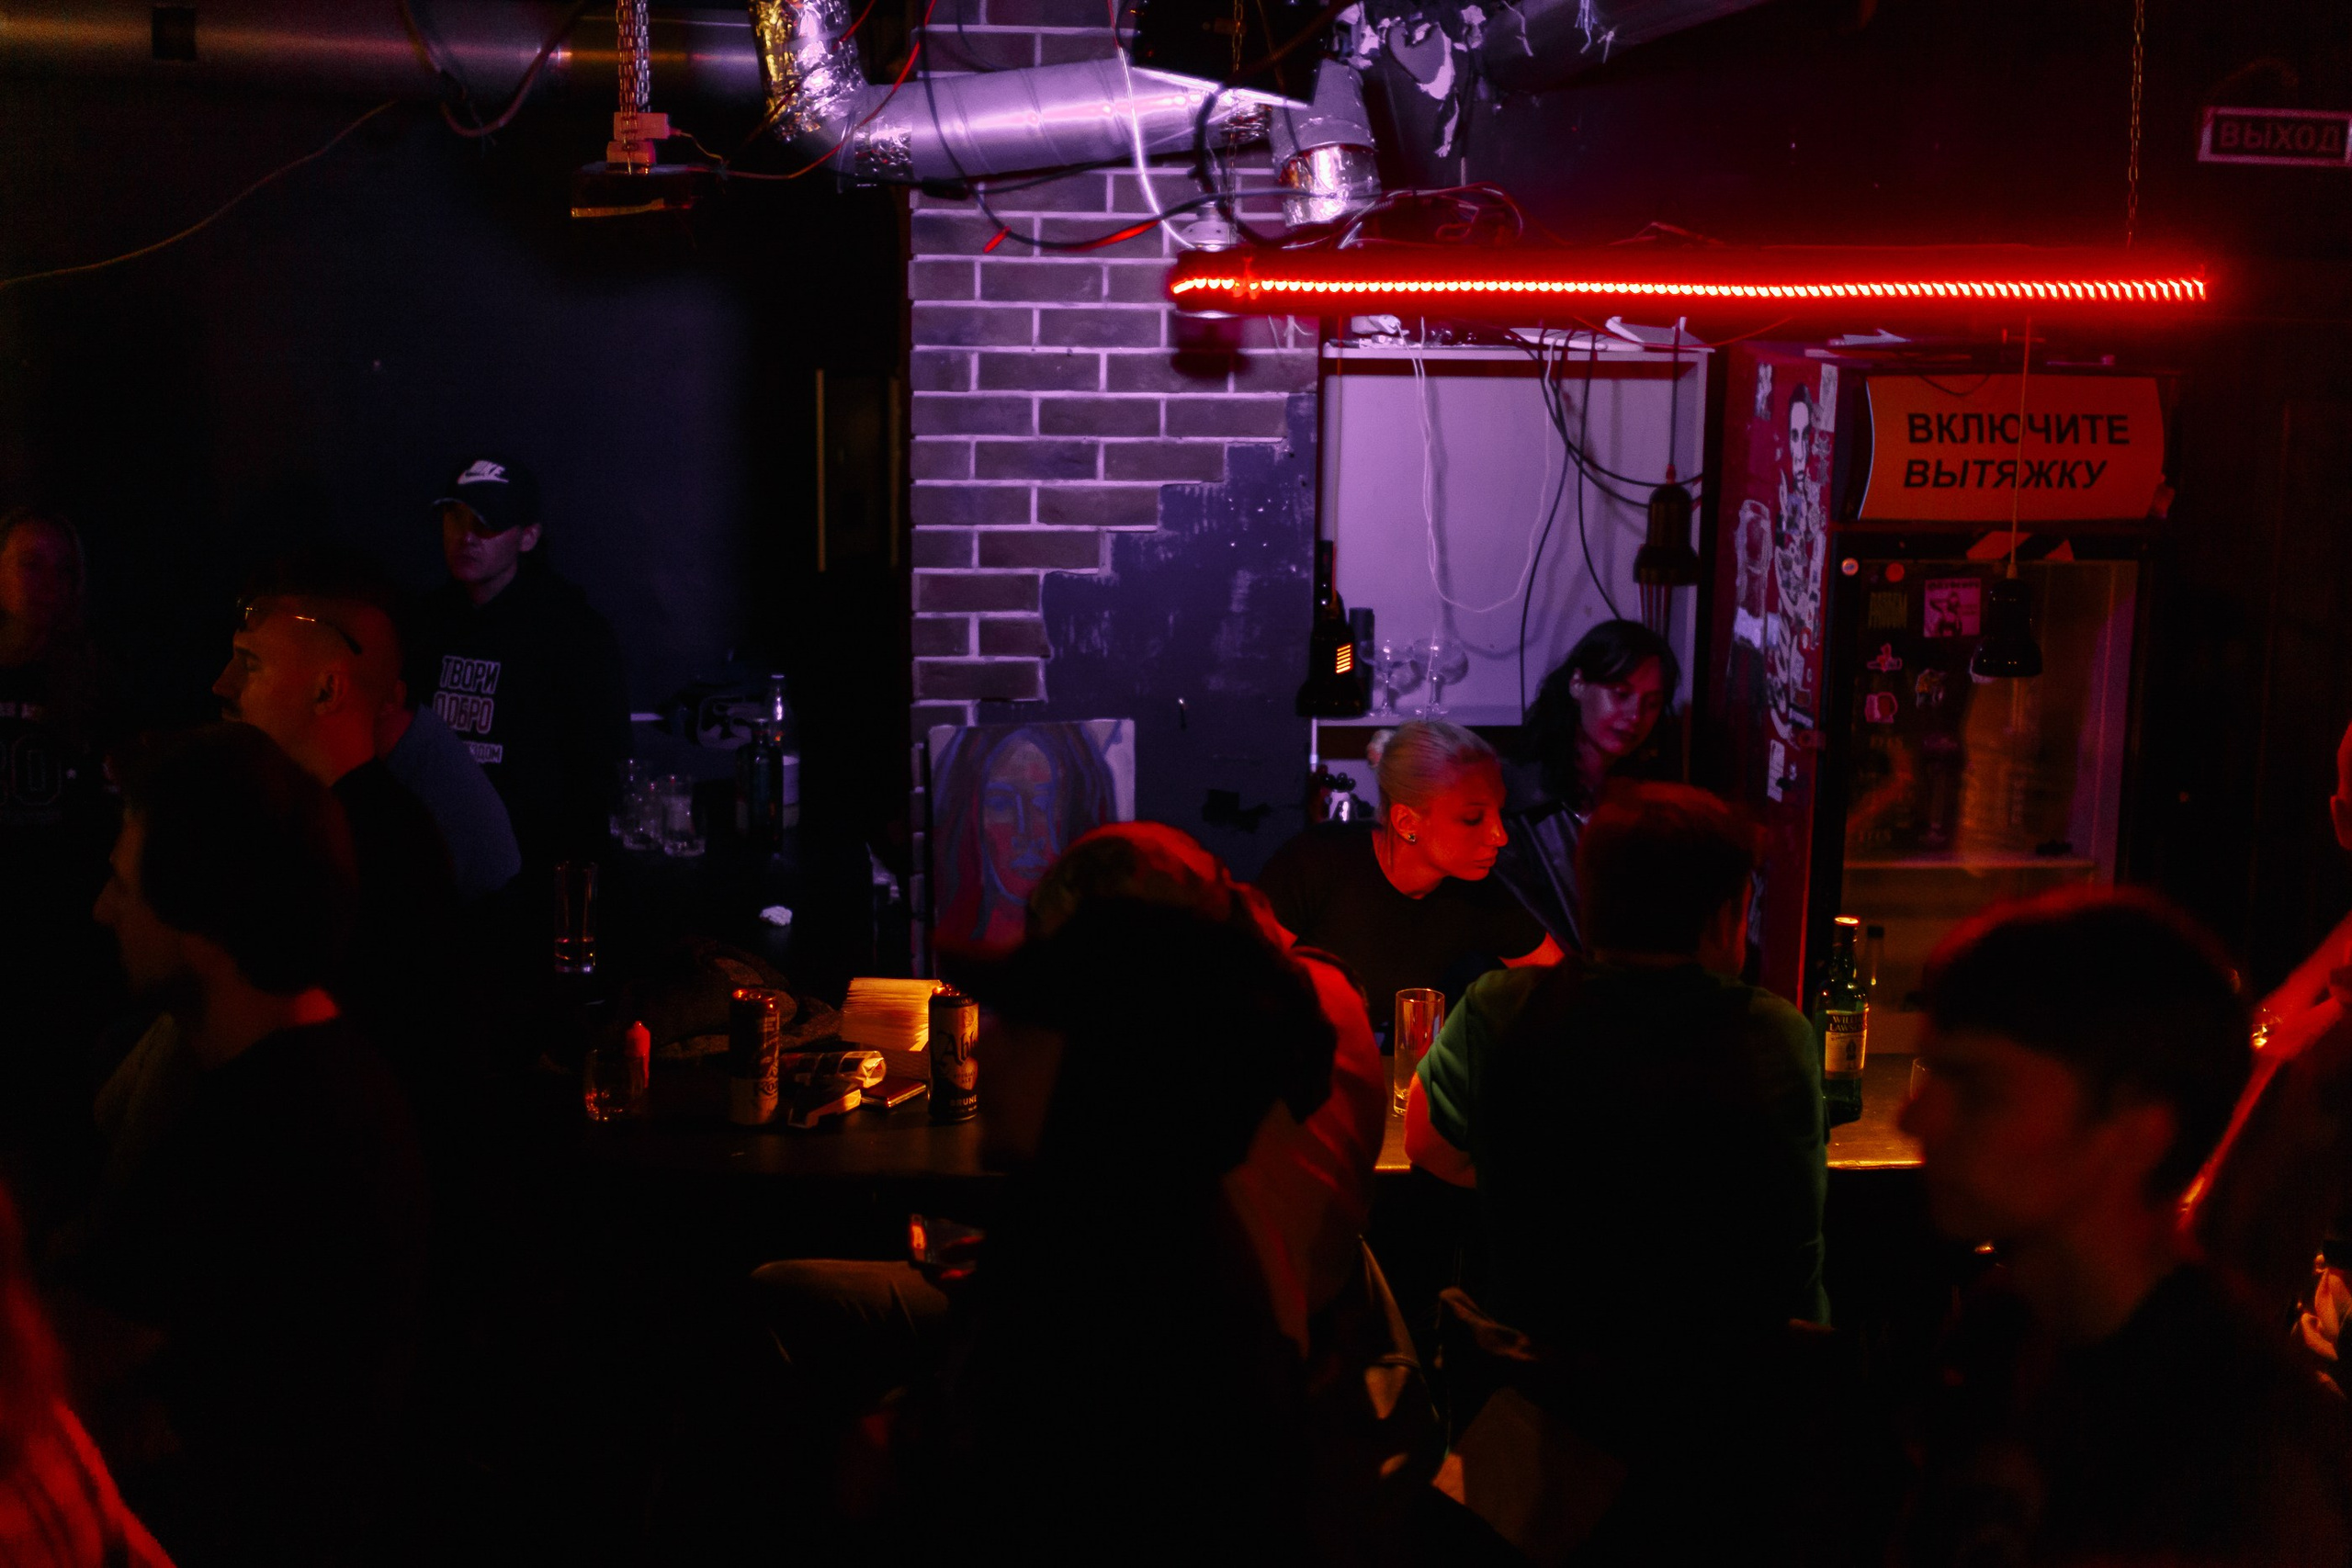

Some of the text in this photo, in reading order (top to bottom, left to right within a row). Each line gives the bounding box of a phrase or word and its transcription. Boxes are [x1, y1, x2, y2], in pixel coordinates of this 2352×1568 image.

[2220, 120, 2341, 153] ВЫХОД
[1907, 412, 2130, 445] ВКЛЮЧИТЕ
[1904, 459, 2108, 489] ВЫТЯЖКУ
[440, 655, 501, 694] ТВОРИ
[433, 691, 493, 733] ДОБРО
